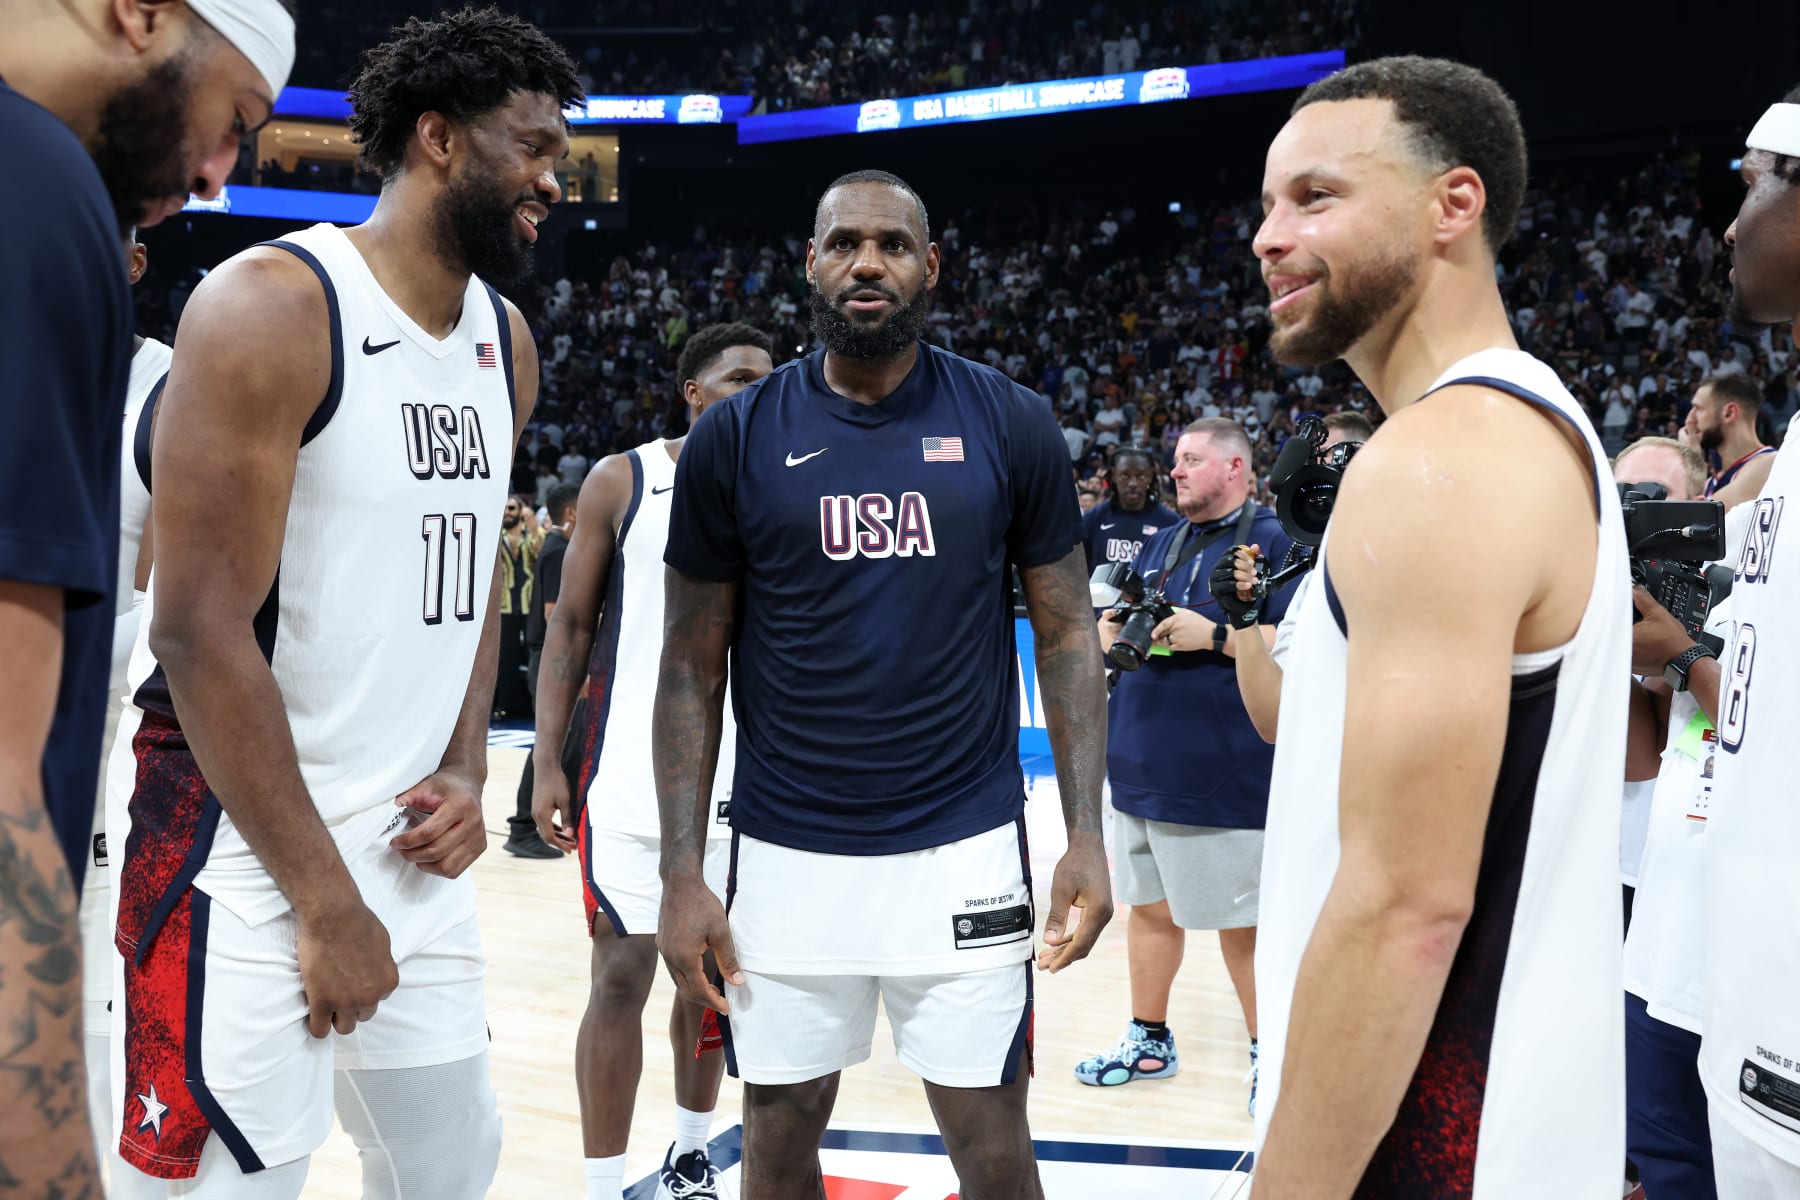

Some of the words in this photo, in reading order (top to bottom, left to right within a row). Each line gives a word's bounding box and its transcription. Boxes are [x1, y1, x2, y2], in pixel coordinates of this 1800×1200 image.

[587, 99, 665, 118] SHOWCASE
[914, 99, 943, 120] USA
[946, 89, 1036, 117] BASKETBALL
[1039, 78, 1124, 107] SHOWCASE
[402, 403, 490, 480] USA
[820, 491, 936, 561] USA
[1734, 496, 1784, 584] USA
[422, 513, 476, 625] 11
[965, 898, 990, 908] SPARKS
[990, 897, 998, 905] OF
[1756, 1045, 1782, 1066] SPARKS
[1783, 1058, 1794, 1070] OF
